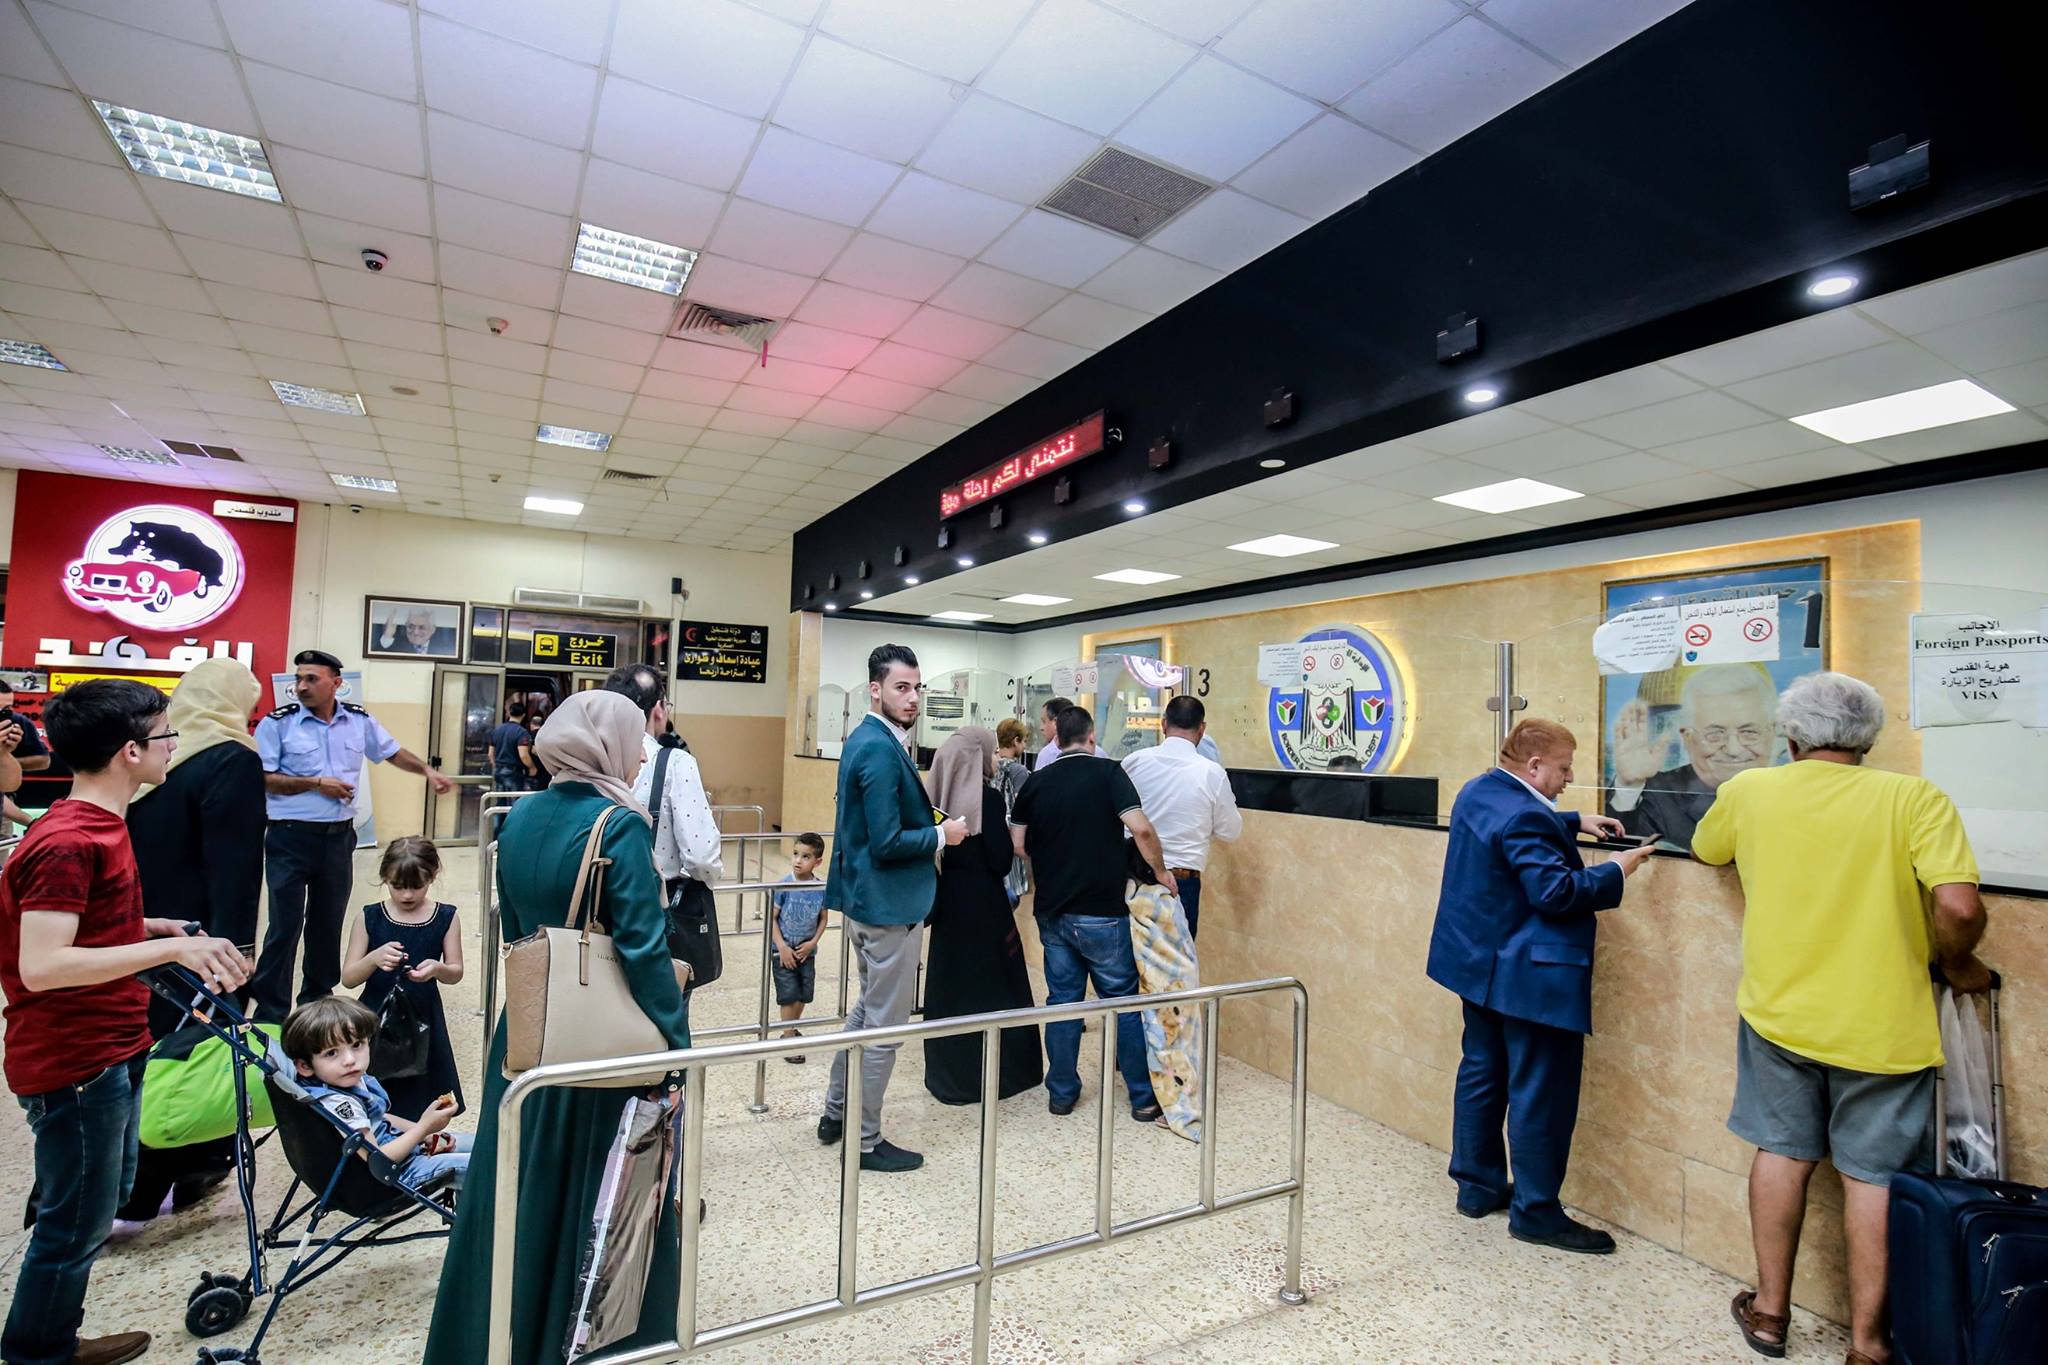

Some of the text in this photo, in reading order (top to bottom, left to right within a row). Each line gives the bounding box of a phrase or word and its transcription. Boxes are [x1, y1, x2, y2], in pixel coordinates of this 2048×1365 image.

[991, 458, 1021, 493] لكم
[1799, 591, 1824, 649] 1
[569, 636, 604, 648] خروج
[1915, 635, 2048, 651] Foreign Passports
[570, 652, 603, 666] Exit
[740, 654, 761, 667] عيادة
[1949, 660, 2010, 674] هوية القدس
[1197, 668, 1210, 697] 3
[1941, 675, 2021, 688] تصاريح الزيارة
[1962, 690, 1999, 700] VISA
[1365, 733, 1380, 758] DEPT
